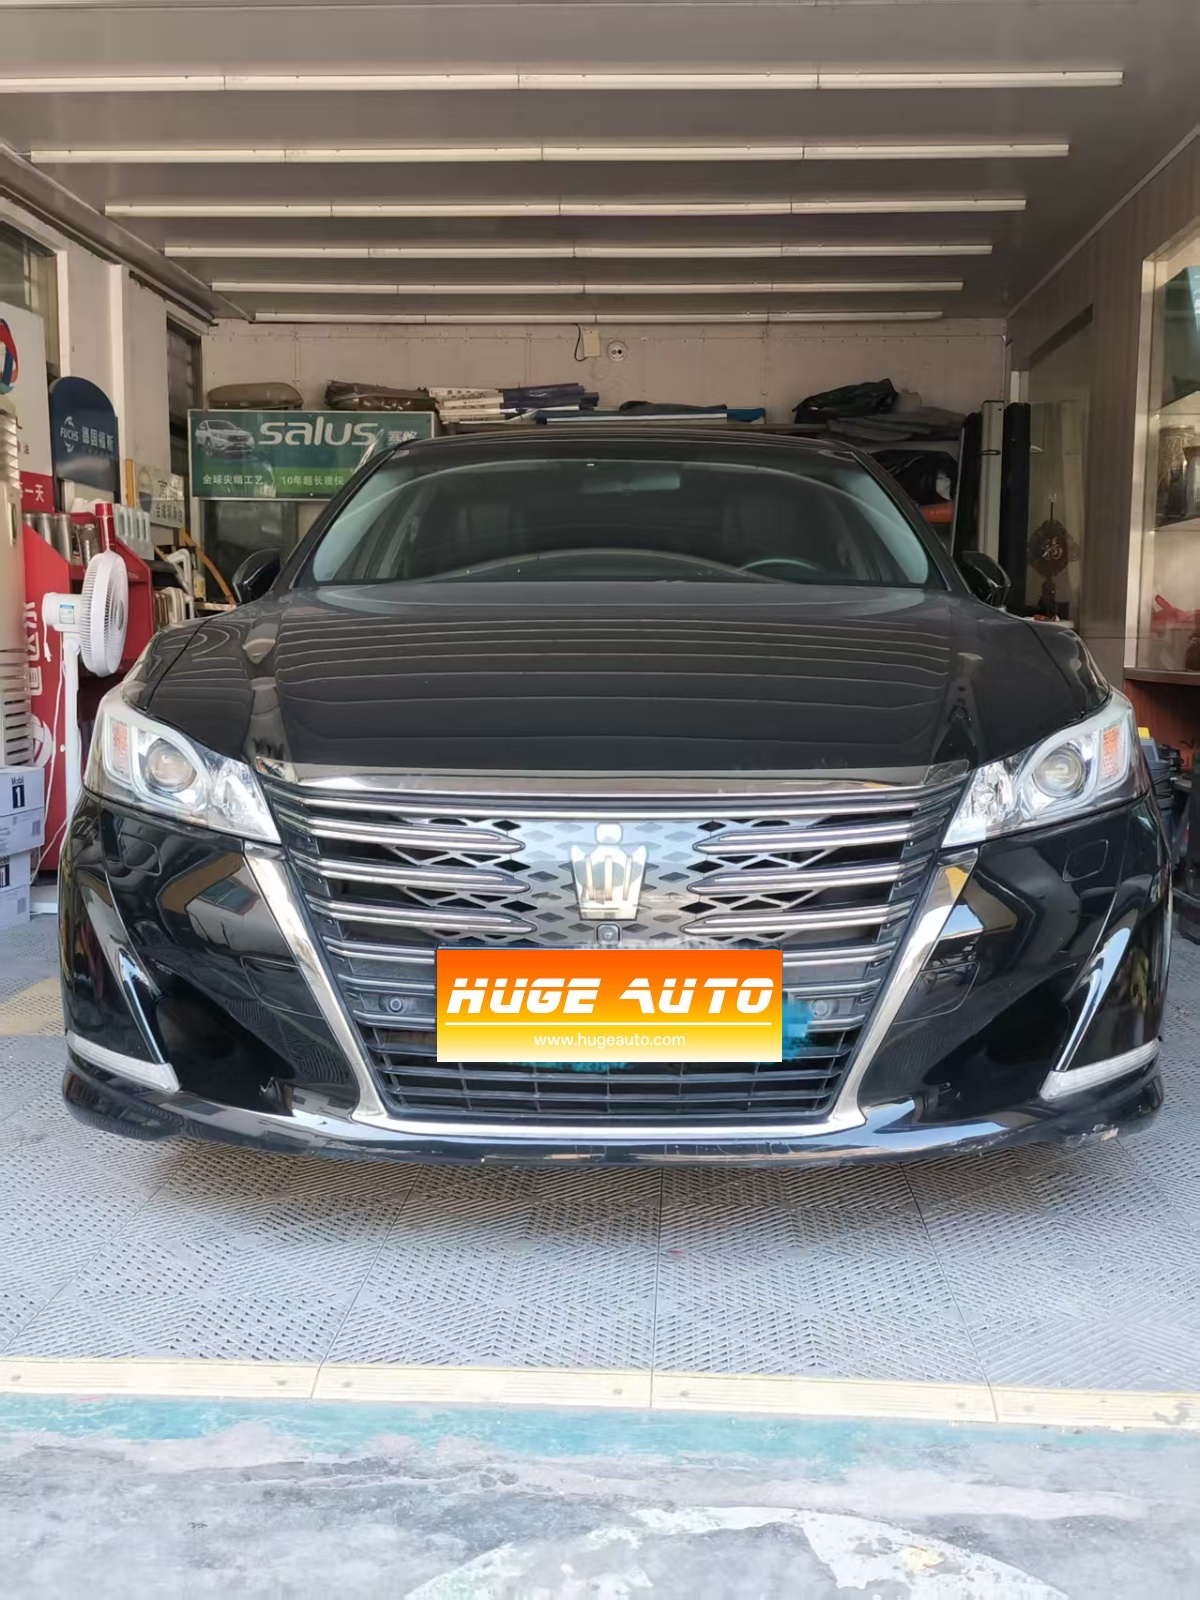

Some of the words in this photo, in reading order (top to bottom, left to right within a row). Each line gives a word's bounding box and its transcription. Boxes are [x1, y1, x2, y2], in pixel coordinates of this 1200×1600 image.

[60, 426, 79, 442] FUCHS
[258, 416, 378, 446] salus
[202, 474, 264, 486] 全球尖端工艺
[20, 482, 45, 502] 一天
